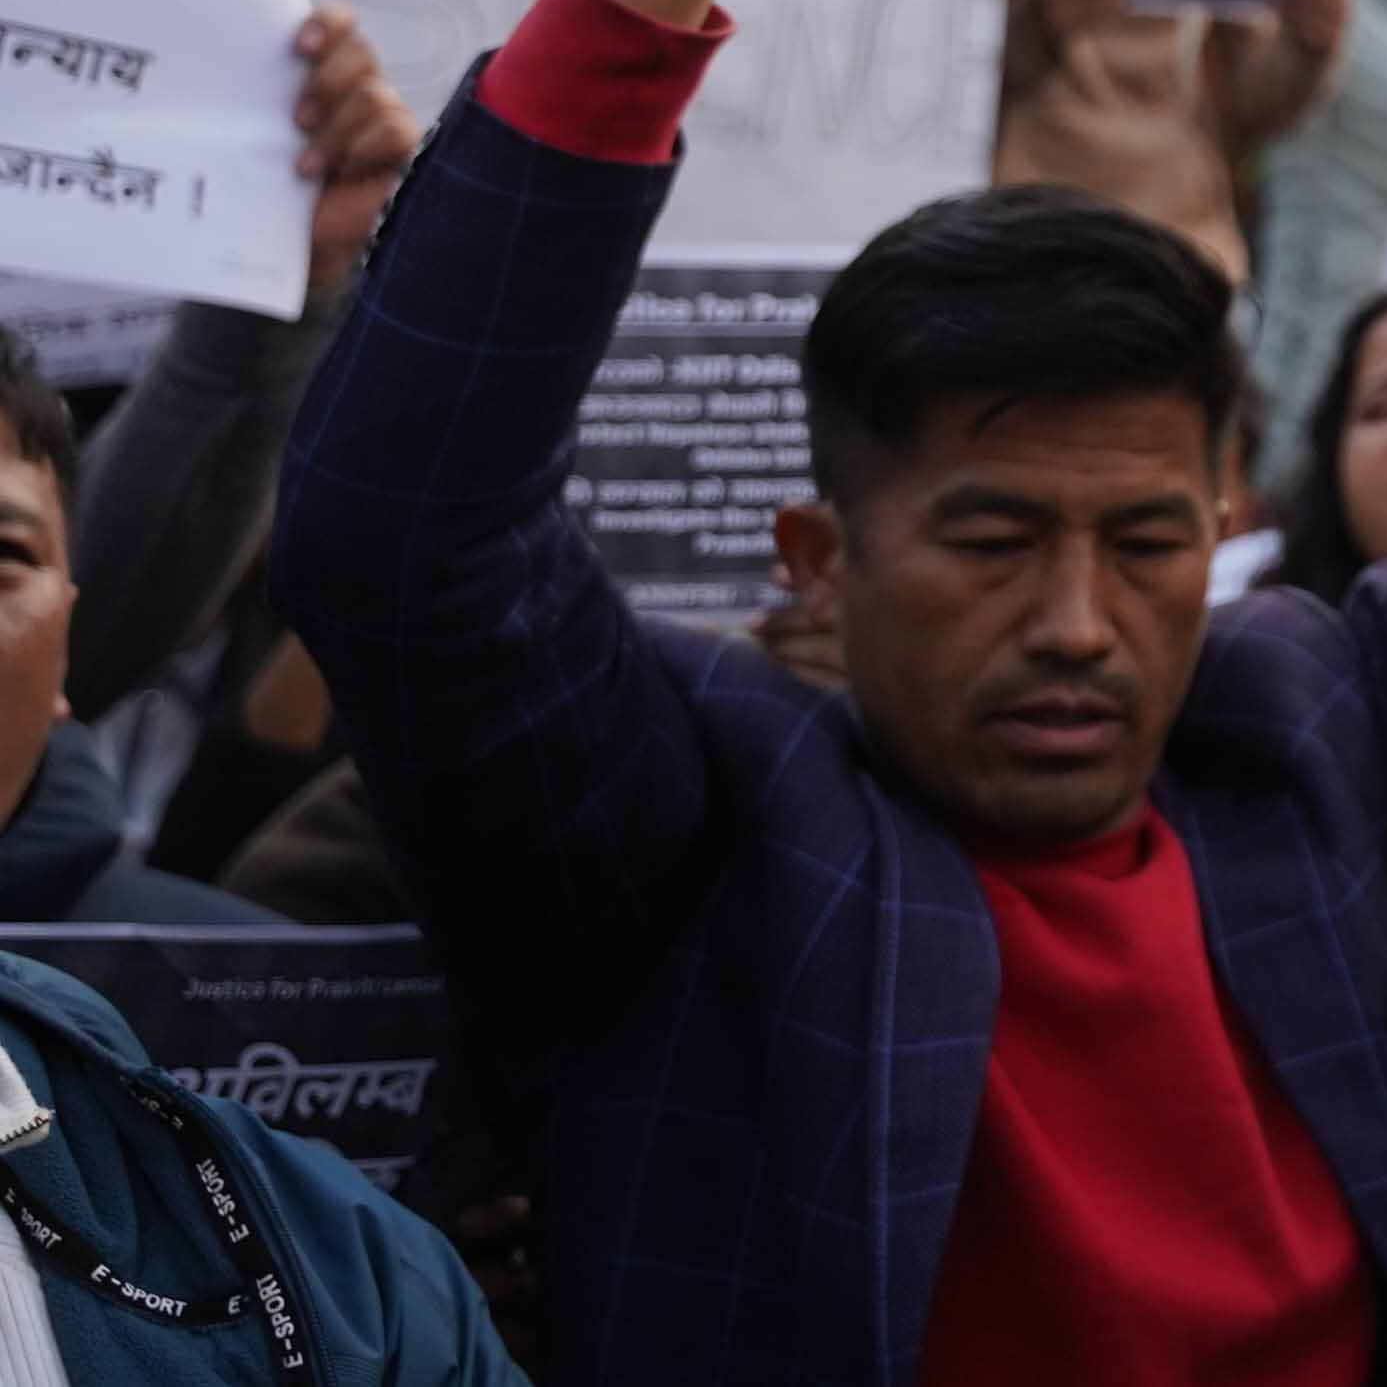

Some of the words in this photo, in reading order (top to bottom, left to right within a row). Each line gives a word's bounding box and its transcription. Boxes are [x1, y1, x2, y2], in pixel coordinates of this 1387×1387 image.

[195, 1157, 251, 1245] E-SPORT
[90, 1264, 188, 1318] E-SPORT
[255, 1272, 304, 1369] E-SPORT
